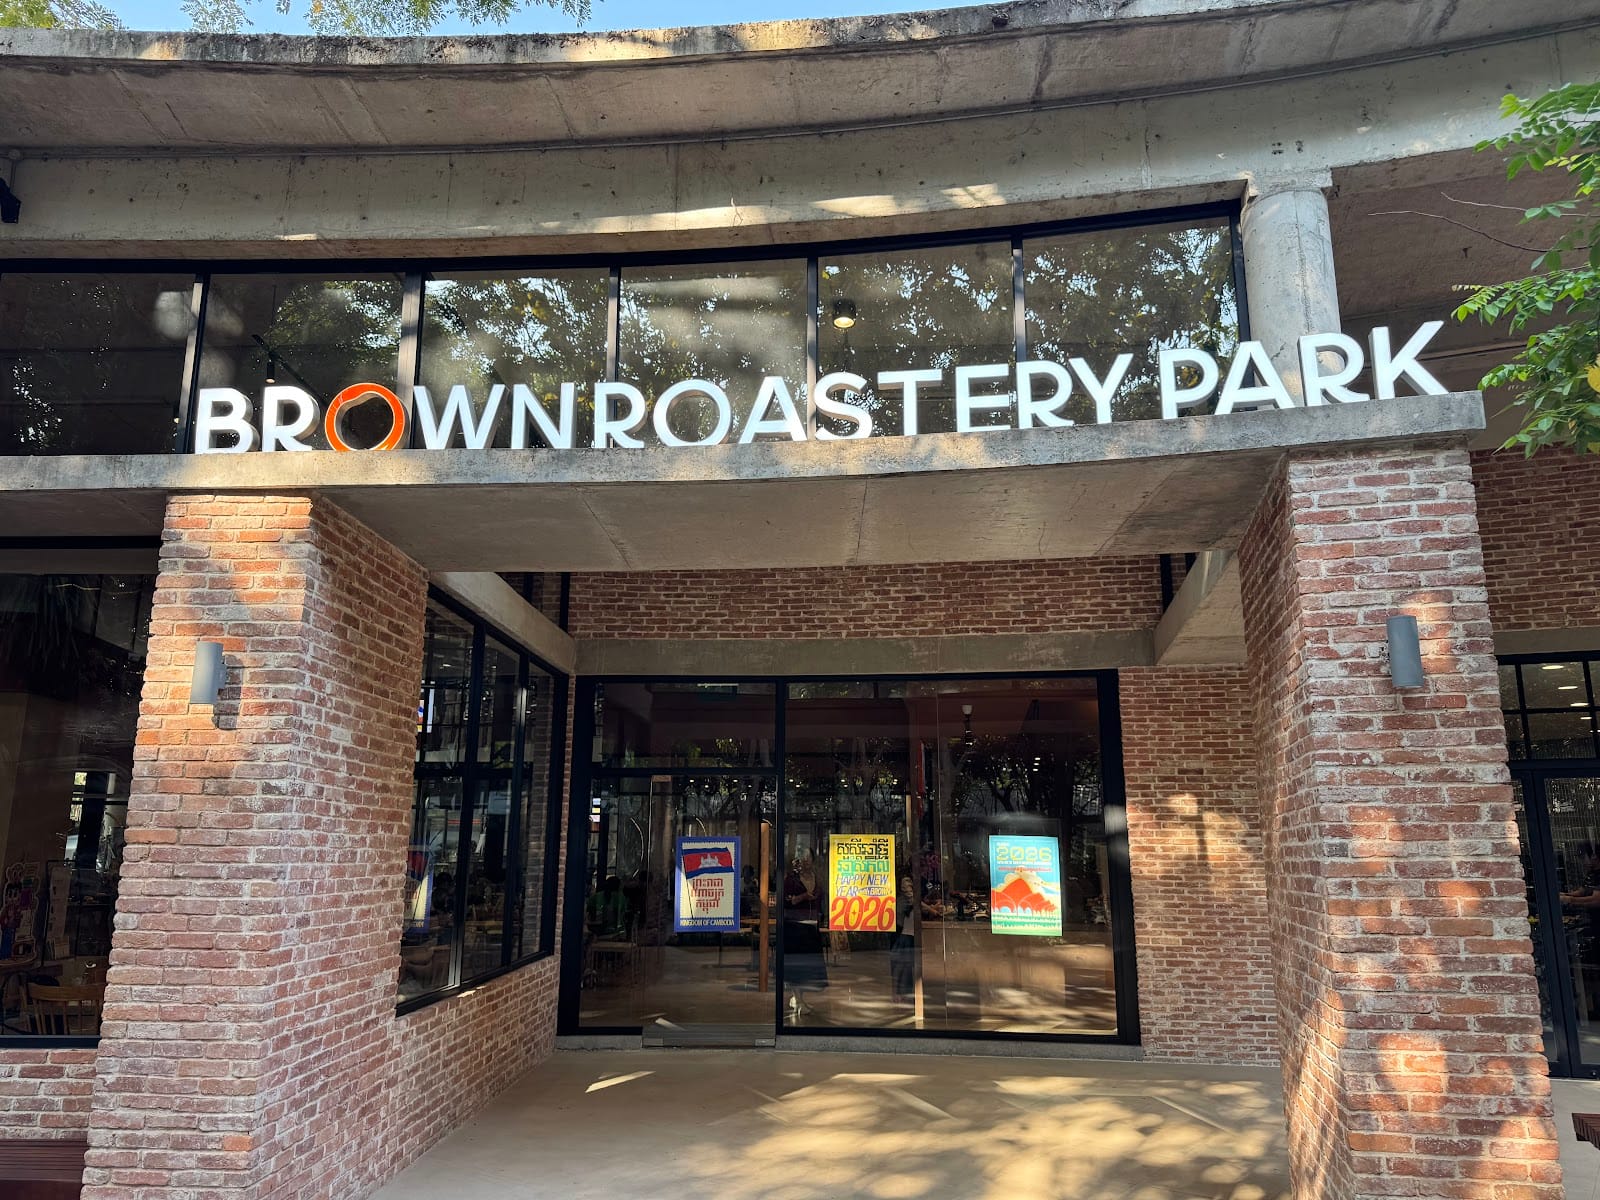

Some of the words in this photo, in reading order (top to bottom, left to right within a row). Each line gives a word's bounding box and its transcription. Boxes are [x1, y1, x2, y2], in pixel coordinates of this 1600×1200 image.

[1159, 320, 1448, 419] PARK
[996, 846, 1053, 862] 2026
[835, 873, 865, 885] HAPPY
[867, 873, 889, 885] NEW
[836, 886, 858, 897] YEAR
[829, 896, 896, 931] 2026
